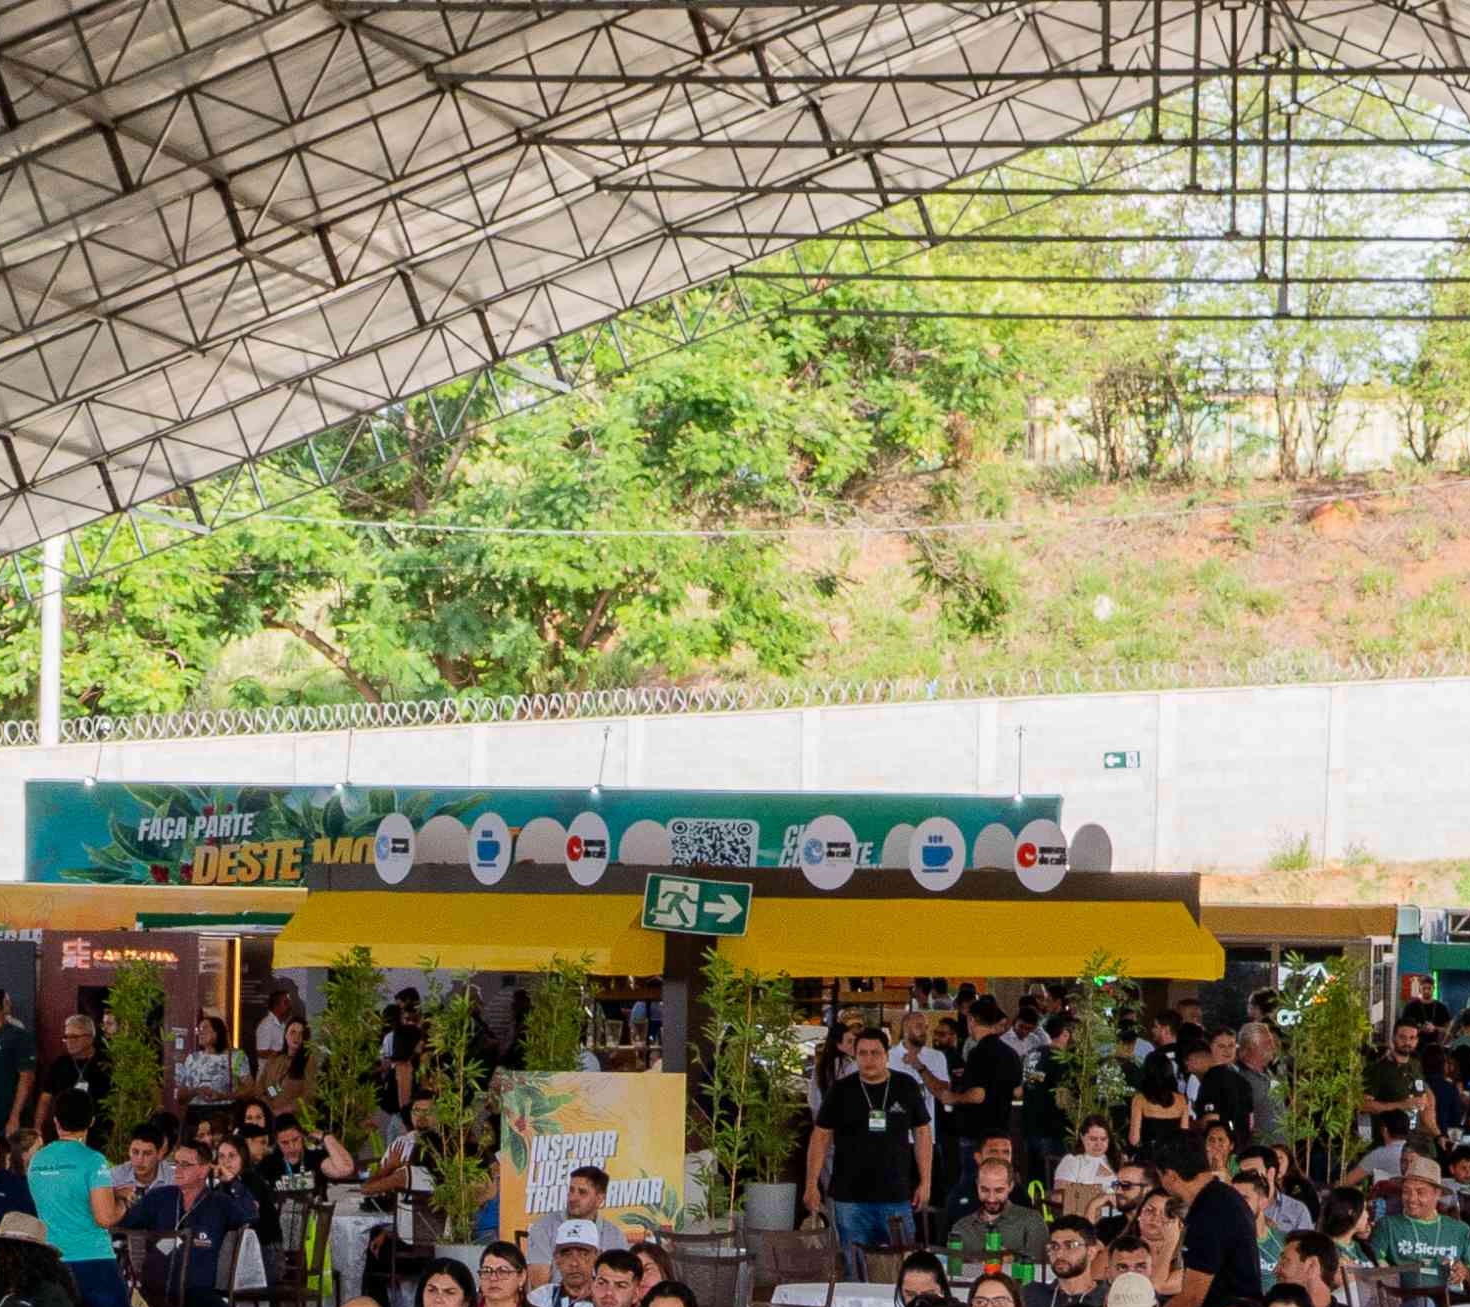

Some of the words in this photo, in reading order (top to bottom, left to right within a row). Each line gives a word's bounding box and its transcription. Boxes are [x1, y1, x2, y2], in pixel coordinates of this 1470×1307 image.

[138, 817, 188, 848] FAÇA
[193, 812, 255, 841] PARTE
[191, 839, 304, 885] DESTE
[530, 1132, 618, 1163] INSPIRAR
[524, 1178, 665, 1215] TRANRMAR
